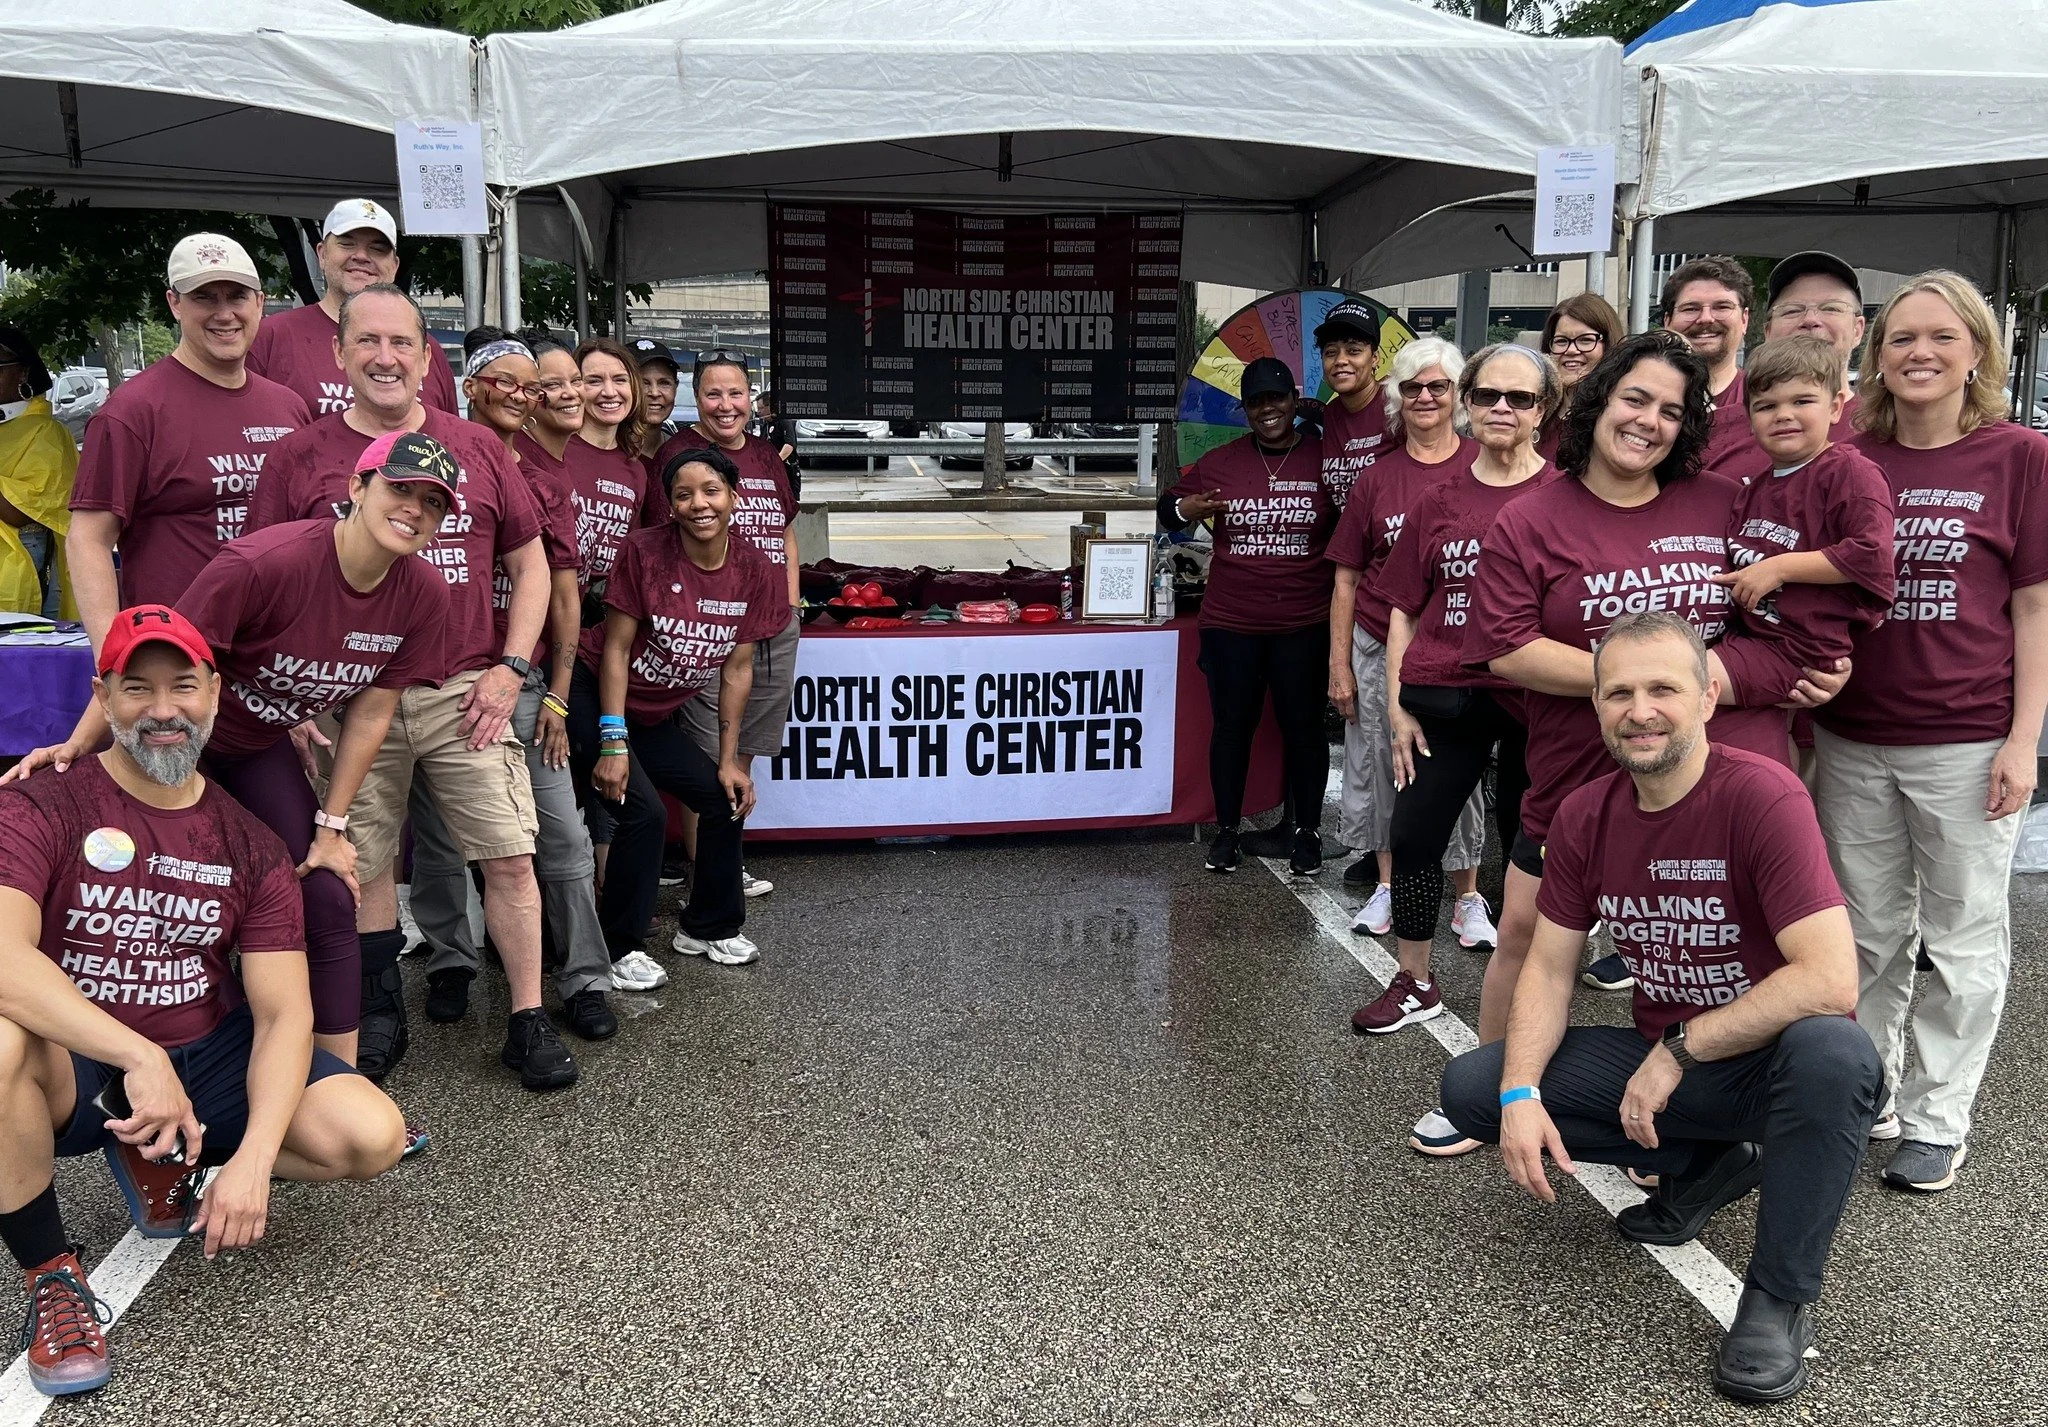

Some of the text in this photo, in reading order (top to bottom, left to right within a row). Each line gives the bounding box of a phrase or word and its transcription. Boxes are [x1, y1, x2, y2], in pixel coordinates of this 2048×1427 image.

[903, 288, 1114, 314] NORTH SIDE CHRISTIAN
[903, 314, 1114, 350] HEALTH CENTER
[1267, 310, 1284, 342] BALL
[1282, 297, 1300, 352] STRESS
[1235, 325, 1265, 358] CAND
[1211, 355, 1242, 387] CAND
[208, 454, 266, 473] WALK
[601, 485, 622, 496] HEALTH
[1334, 484, 1349, 492] FO
[1910, 489, 1985, 503] NORTH SIDE CHRISTIAN
[733, 497, 781, 511] ALKING
[1227, 497, 1312, 511] WALKING
[1907, 496, 1982, 513] HEALTH CENTER
[728, 511, 785, 526] OGETHER
[1224, 510, 1317, 525] TOGETHER
[740, 526, 768, 535] FOR A
[1250, 525, 1273, 533] FOR
[1894, 518, 1965, 538] KING
[752, 537, 784, 550] THIER
[1229, 534, 1309, 545] HEALTHIER
[1658, 536, 1724, 545] NORTH SIDE CHRISTIAN
[1766, 532, 1797, 550] CENTR
[1229, 543, 1309, 556] NORTHSIDE
[1661, 543, 1725, 555] HEALTH CENTER
[1894, 539, 1969, 562] THER
[1899, 563, 1911, 575] A
[703, 606, 726, 615] HEALTH
[1687, 608, 1700, 621] A
[350, 631, 371, 642] NORTH
[652, 615, 738, 641] WALKING
[348, 640, 380, 652] HEALTH
[643, 647, 717, 680] HEALTHIE
[671, 654, 709, 667] FOR A
[254, 666, 364, 701] TOGETH
[891, 674, 965, 721] SIDE
[975, 668, 1143, 719] CHRISTIAN
[771, 717, 1143, 781] HEALTH CENTER
[159, 855, 232, 876] NORTH SIDE CHRISTIAN
[1657, 860, 1679, 869] NORTH
[1691, 860, 1726, 869] CHRISTIAN
[158, 864, 231, 886] HEALTH CENTER
[1690, 869, 1727, 881] CENTER
[79, 882, 222, 923] WALKING
[1597, 895, 1726, 921] WALKING
[66, 909, 223, 946] TOGETHER
[115, 940, 173, 957] FOR A
[1641, 943, 1692, 962] FOR A
[61, 949, 205, 981] HEALTHIER
[70, 975, 210, 1006] ORTHSIDE
